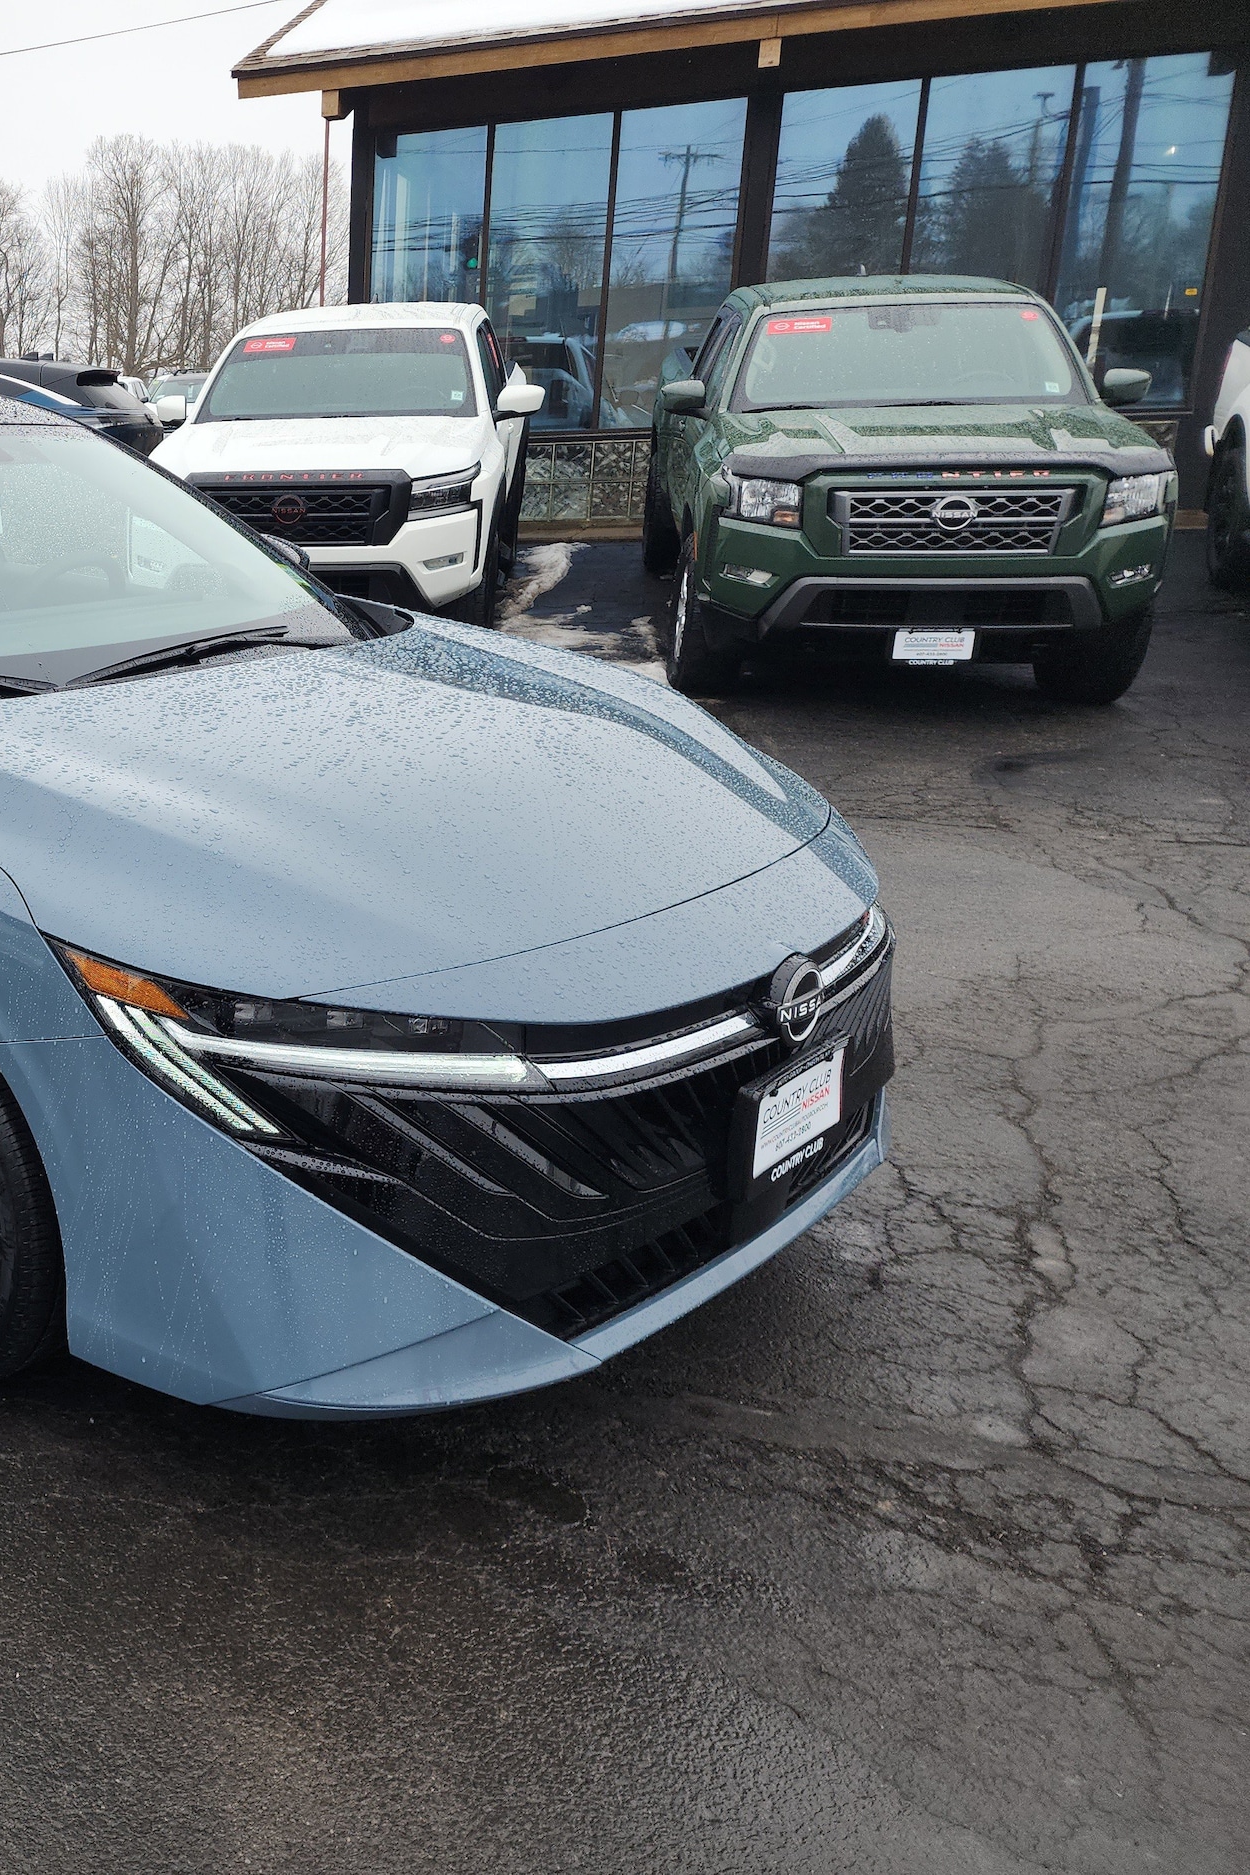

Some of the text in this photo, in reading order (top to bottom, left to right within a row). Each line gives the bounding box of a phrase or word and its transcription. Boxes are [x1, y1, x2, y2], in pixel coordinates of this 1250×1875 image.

[223, 472, 364, 481] FRONTIER
[931, 511, 978, 519] NISSAN
[780, 993, 825, 1022] NISSA
[763, 1068, 832, 1124] COUNTRY CLUB
[801, 1085, 831, 1111] NISSAN
[770, 1136, 824, 1182] COUNTRY CLUB
